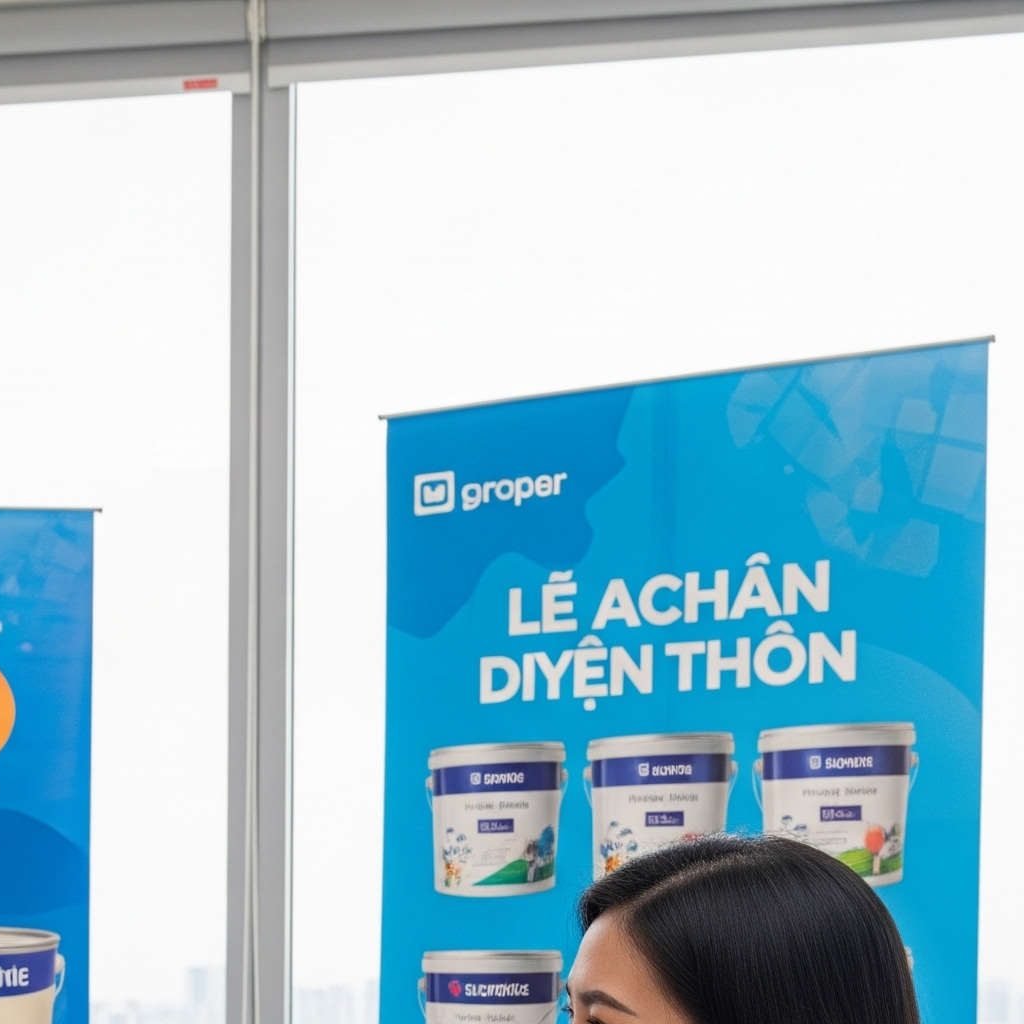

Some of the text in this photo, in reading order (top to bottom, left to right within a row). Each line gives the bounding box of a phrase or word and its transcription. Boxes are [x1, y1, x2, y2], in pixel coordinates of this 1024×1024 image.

[461, 472, 568, 511] groper
[508, 551, 831, 637] LẼ ACHÂN
[479, 620, 857, 711] DIYỆN THÔN
